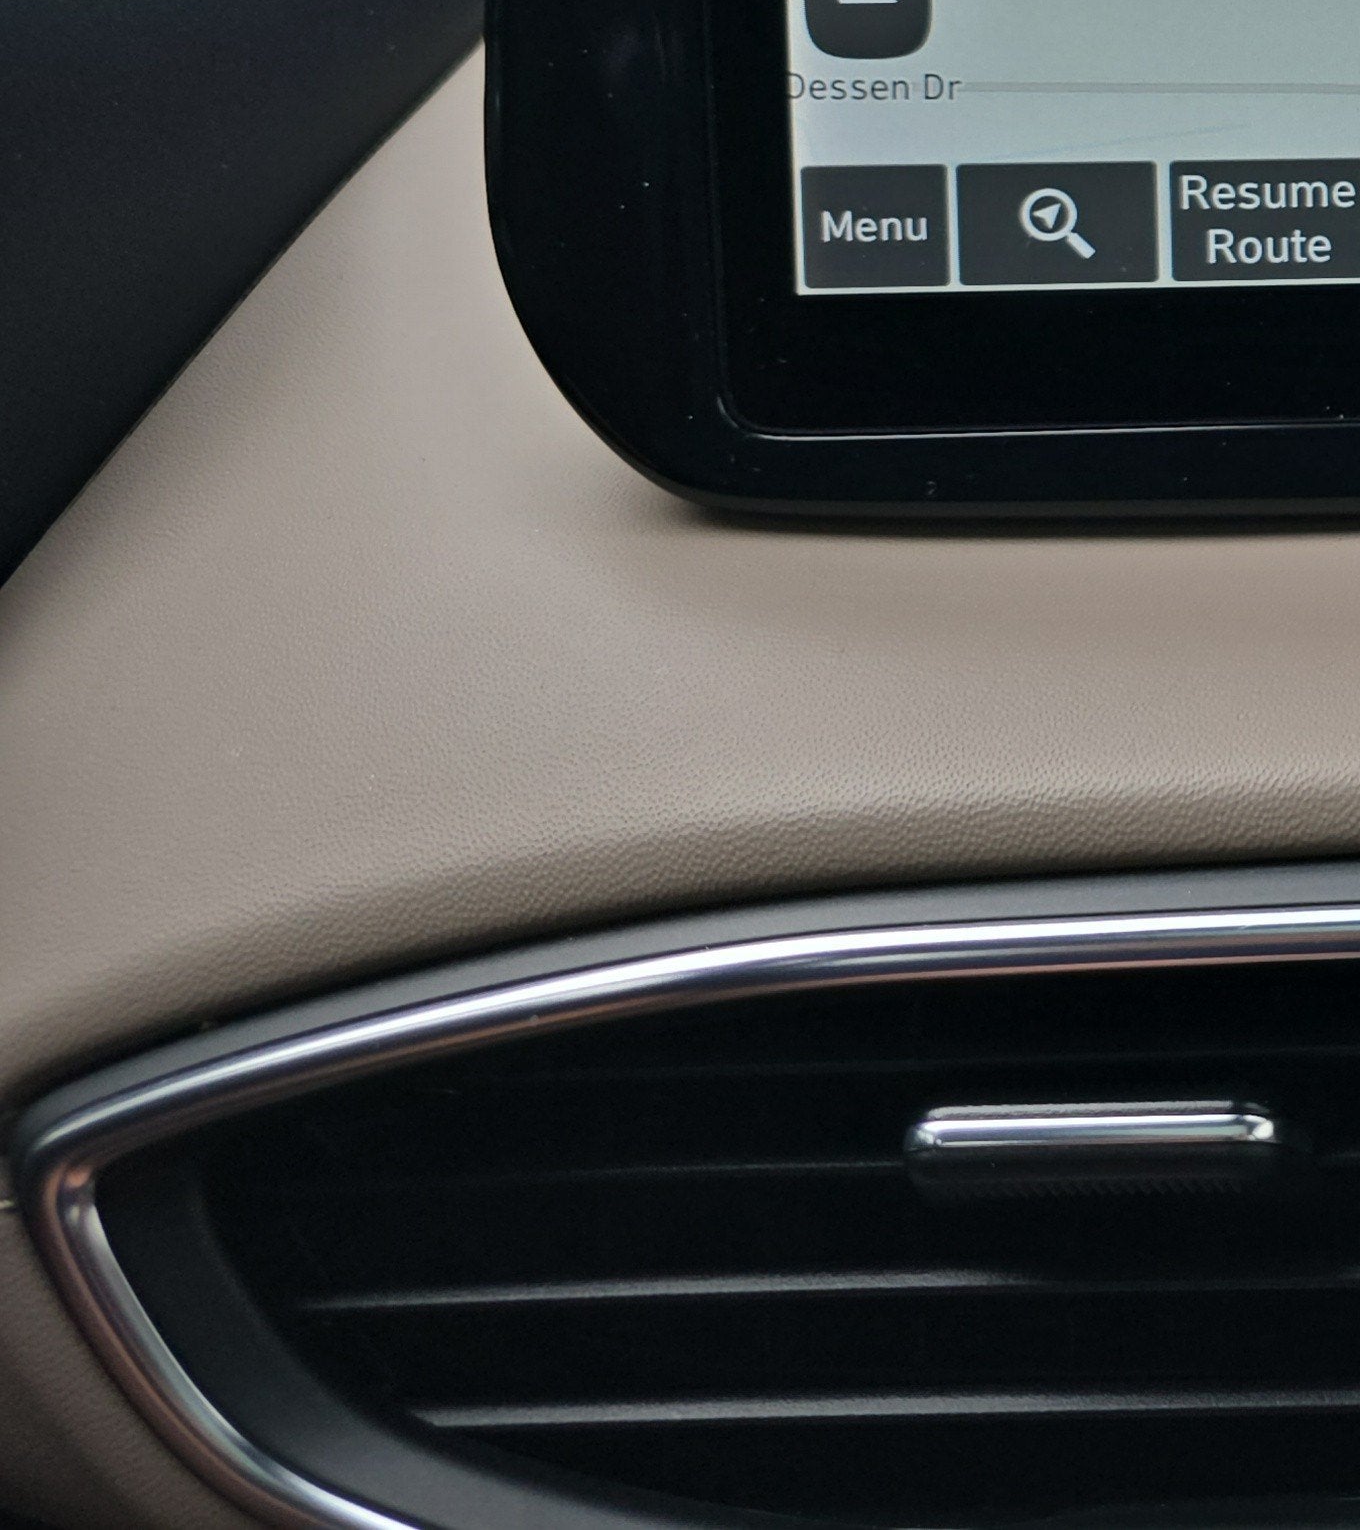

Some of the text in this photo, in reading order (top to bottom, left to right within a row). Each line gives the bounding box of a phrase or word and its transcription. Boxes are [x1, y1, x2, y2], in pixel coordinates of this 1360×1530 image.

[924, 73, 962, 101] Dr
[1179, 174, 1357, 212] Resume
[821, 211, 928, 243] Menu
[1207, 227, 1332, 265] Route
